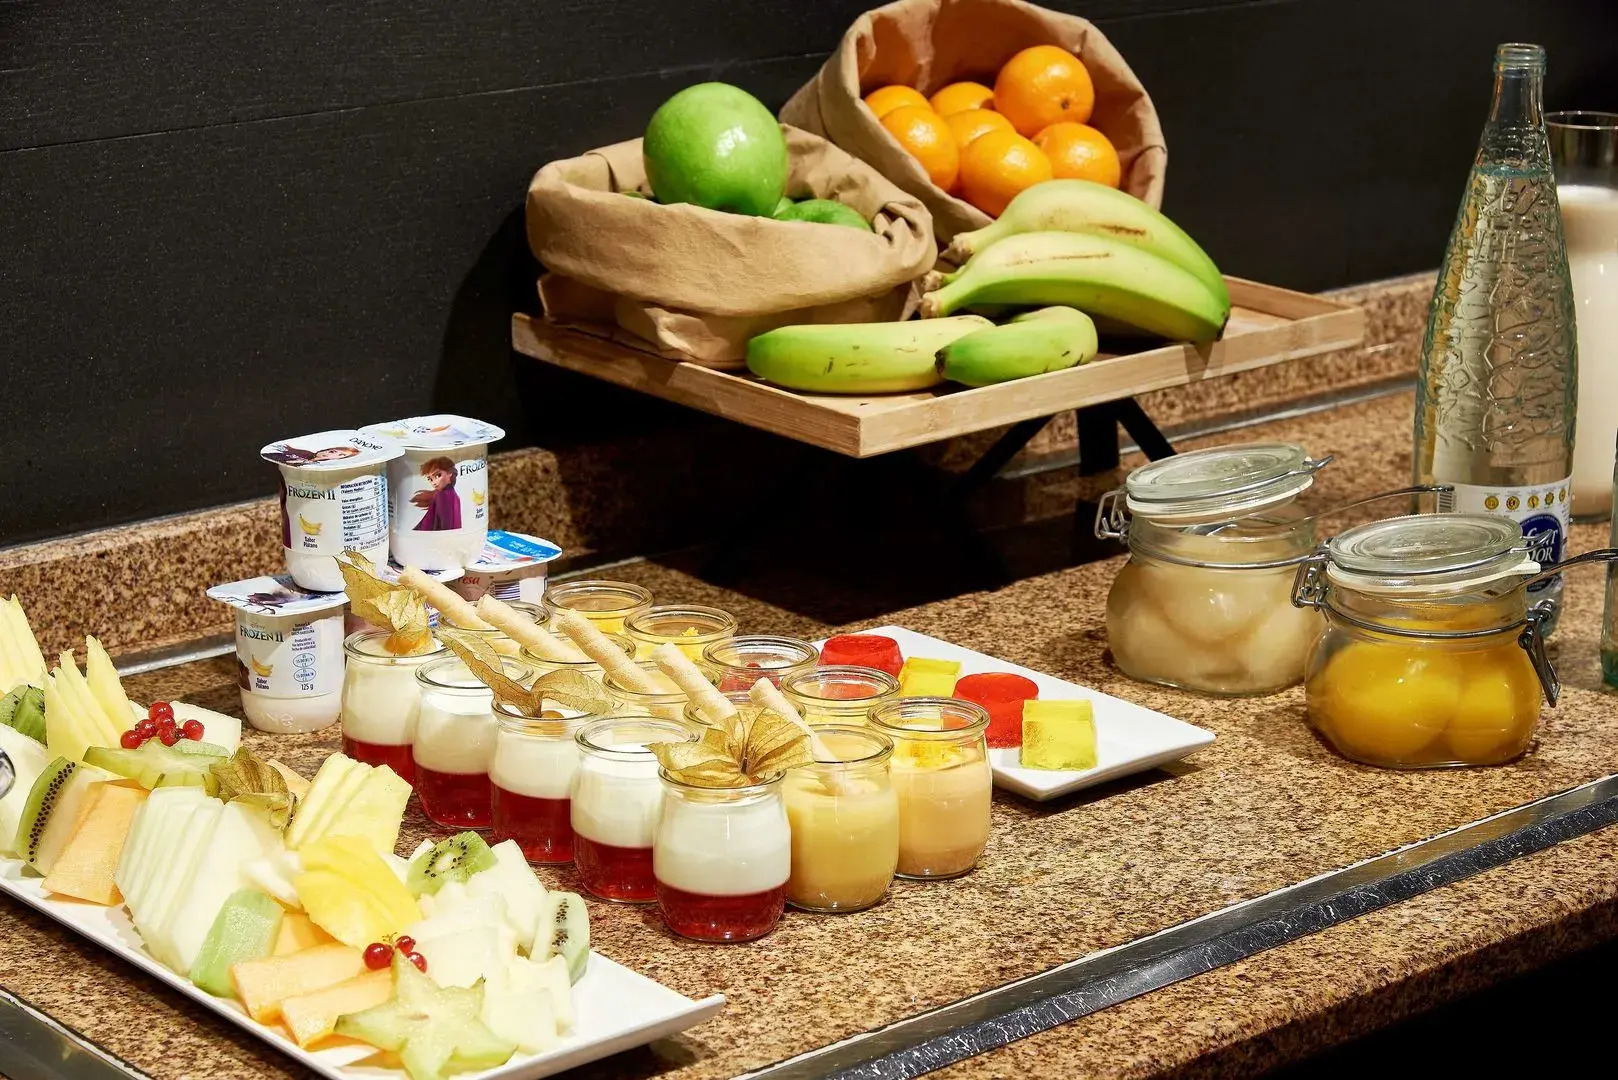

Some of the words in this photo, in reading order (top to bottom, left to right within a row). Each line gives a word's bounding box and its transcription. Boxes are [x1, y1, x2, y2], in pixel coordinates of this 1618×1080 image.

[288, 485, 326, 500] FROZEN
[327, 489, 336, 501] II
[240, 625, 274, 641] FROZEN
[275, 631, 285, 643] II
[301, 683, 310, 691] 125
